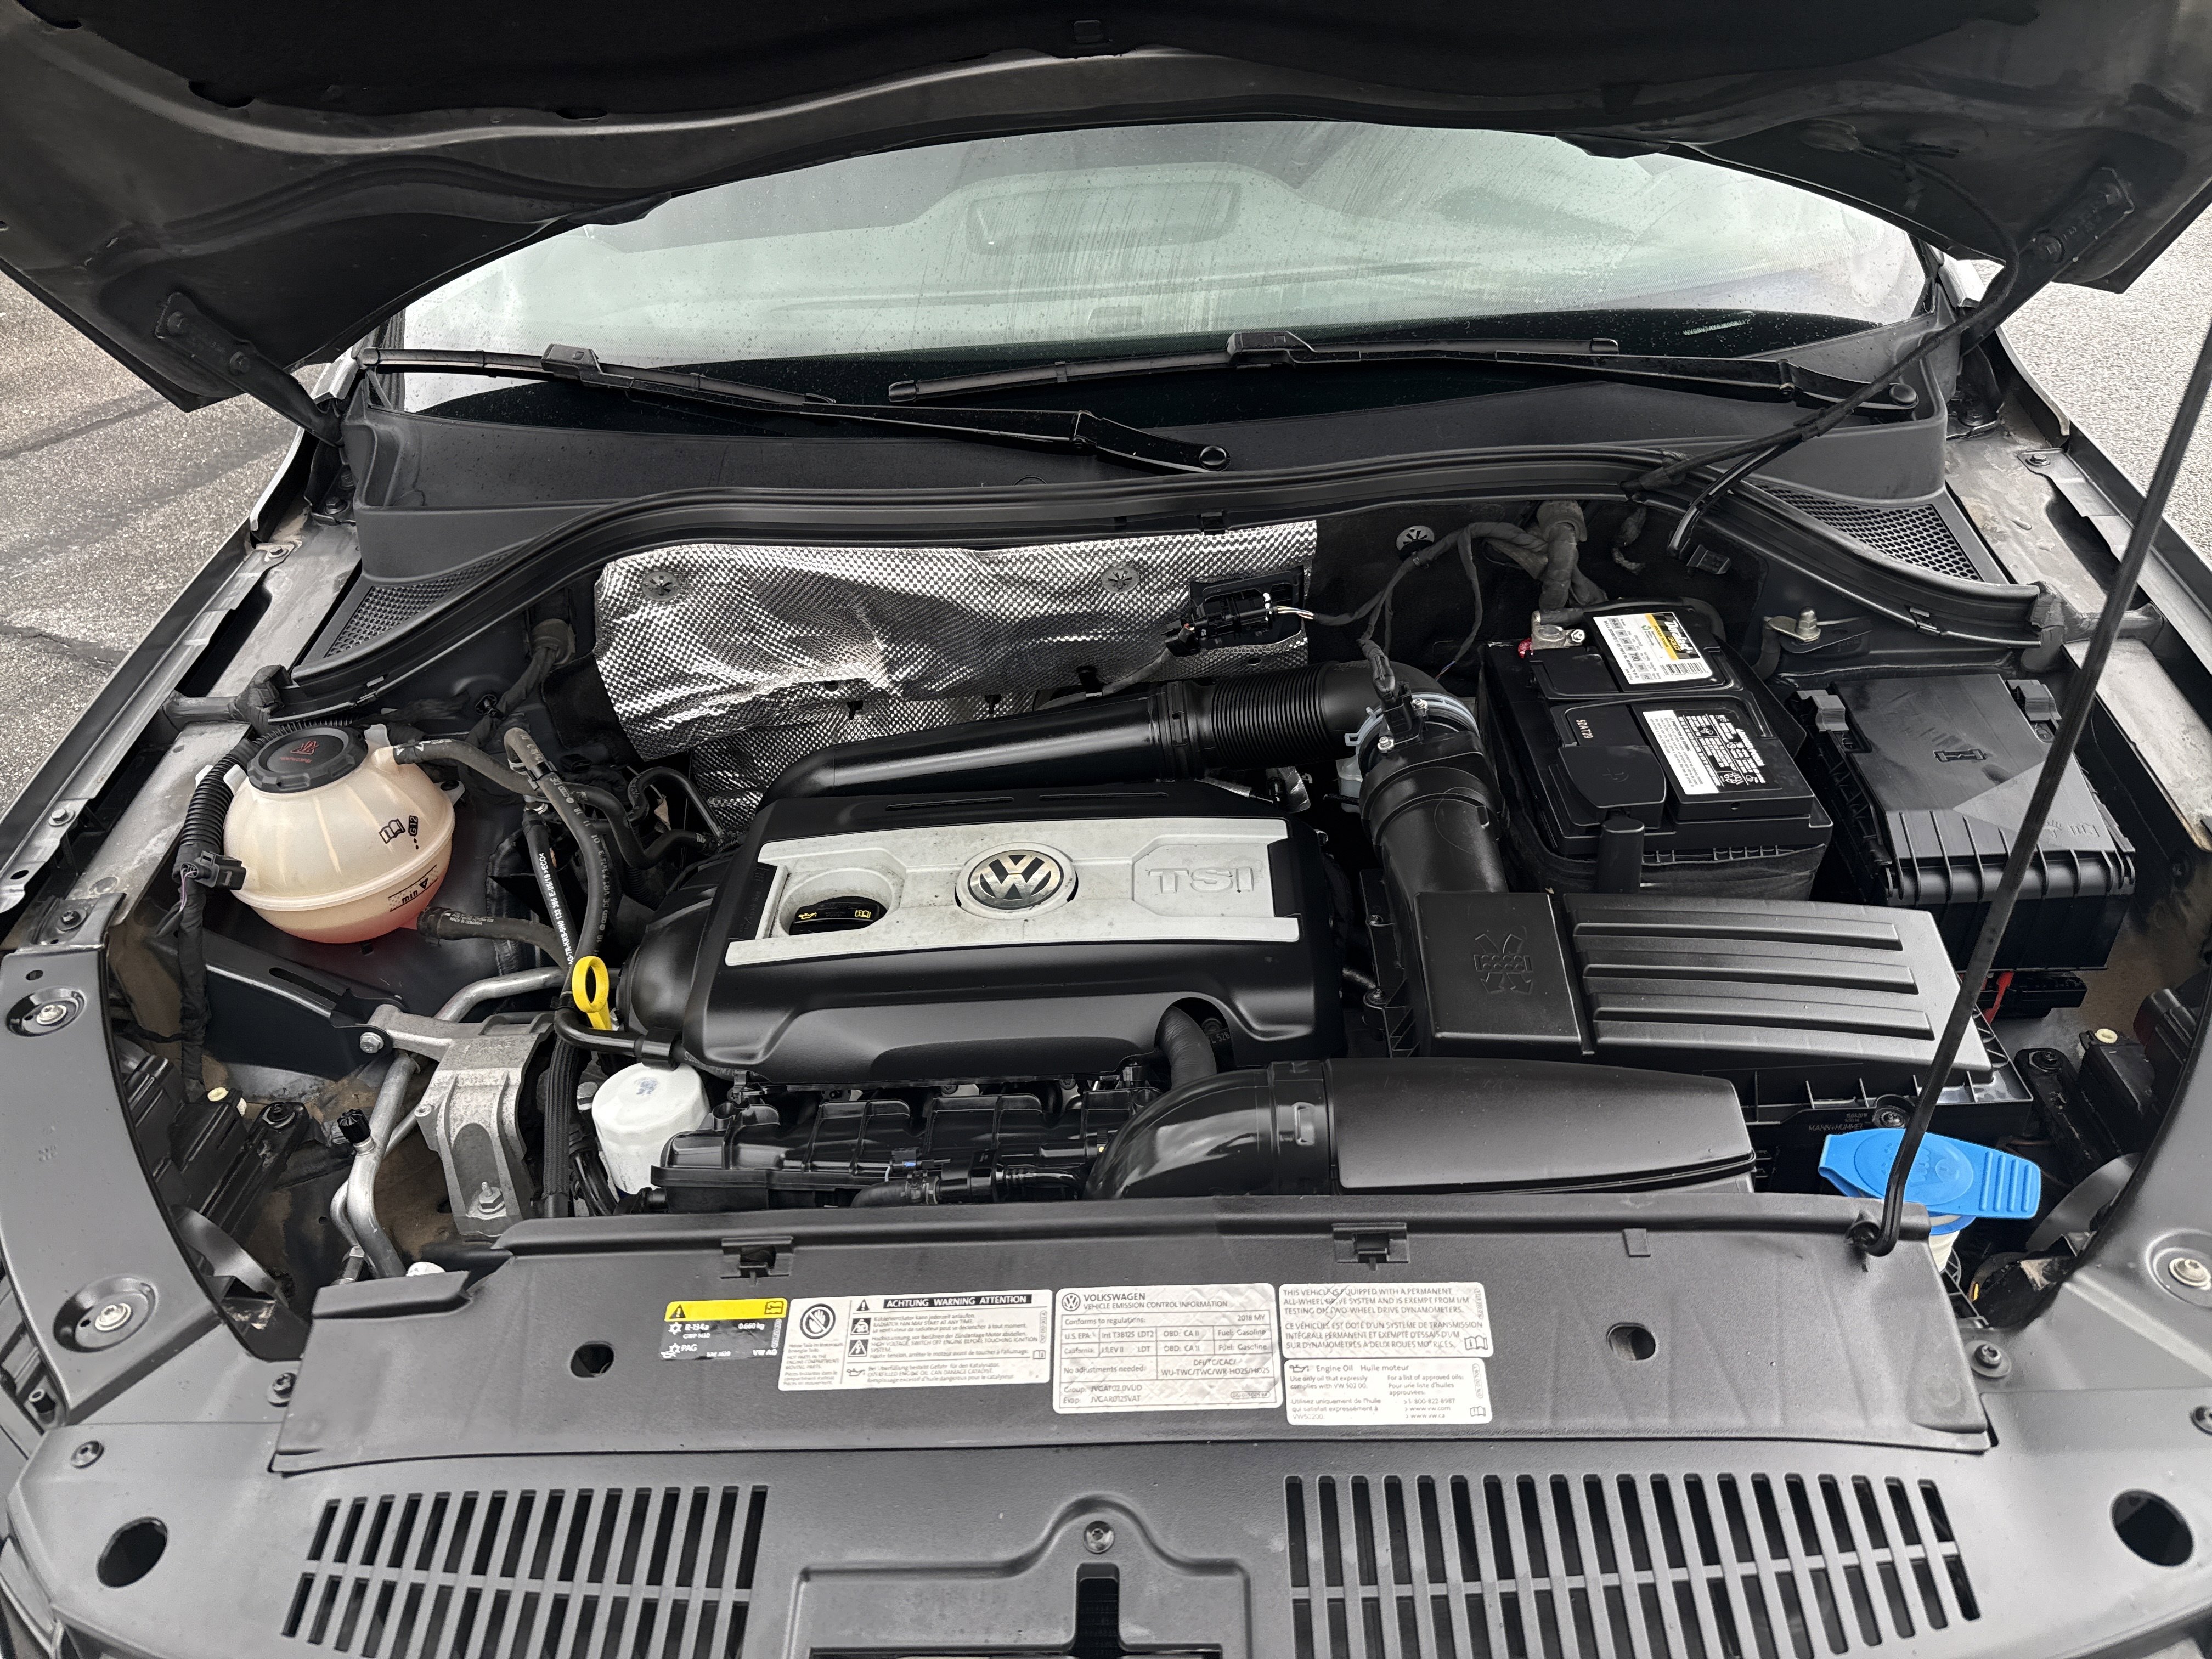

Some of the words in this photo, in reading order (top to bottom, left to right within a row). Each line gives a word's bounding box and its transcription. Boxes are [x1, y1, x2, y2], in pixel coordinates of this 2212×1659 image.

[1664, 620, 1694, 654] Duralast
[1668, 637, 1680, 650] GOLD
[1148, 867, 1254, 893] TSI
[402, 890, 418, 904] min
[551, 897, 559, 909] 366
[554, 909, 562, 920] 133
[887, 1299, 929, 1307] ACHTUNG
[934, 1297, 975, 1306] WARNING
[979, 1296, 1026, 1304] ATTENTION
[1084, 1293, 1146, 1301] VOLKSWAGEN
[1316, 1365, 1341, 1373] Engine
